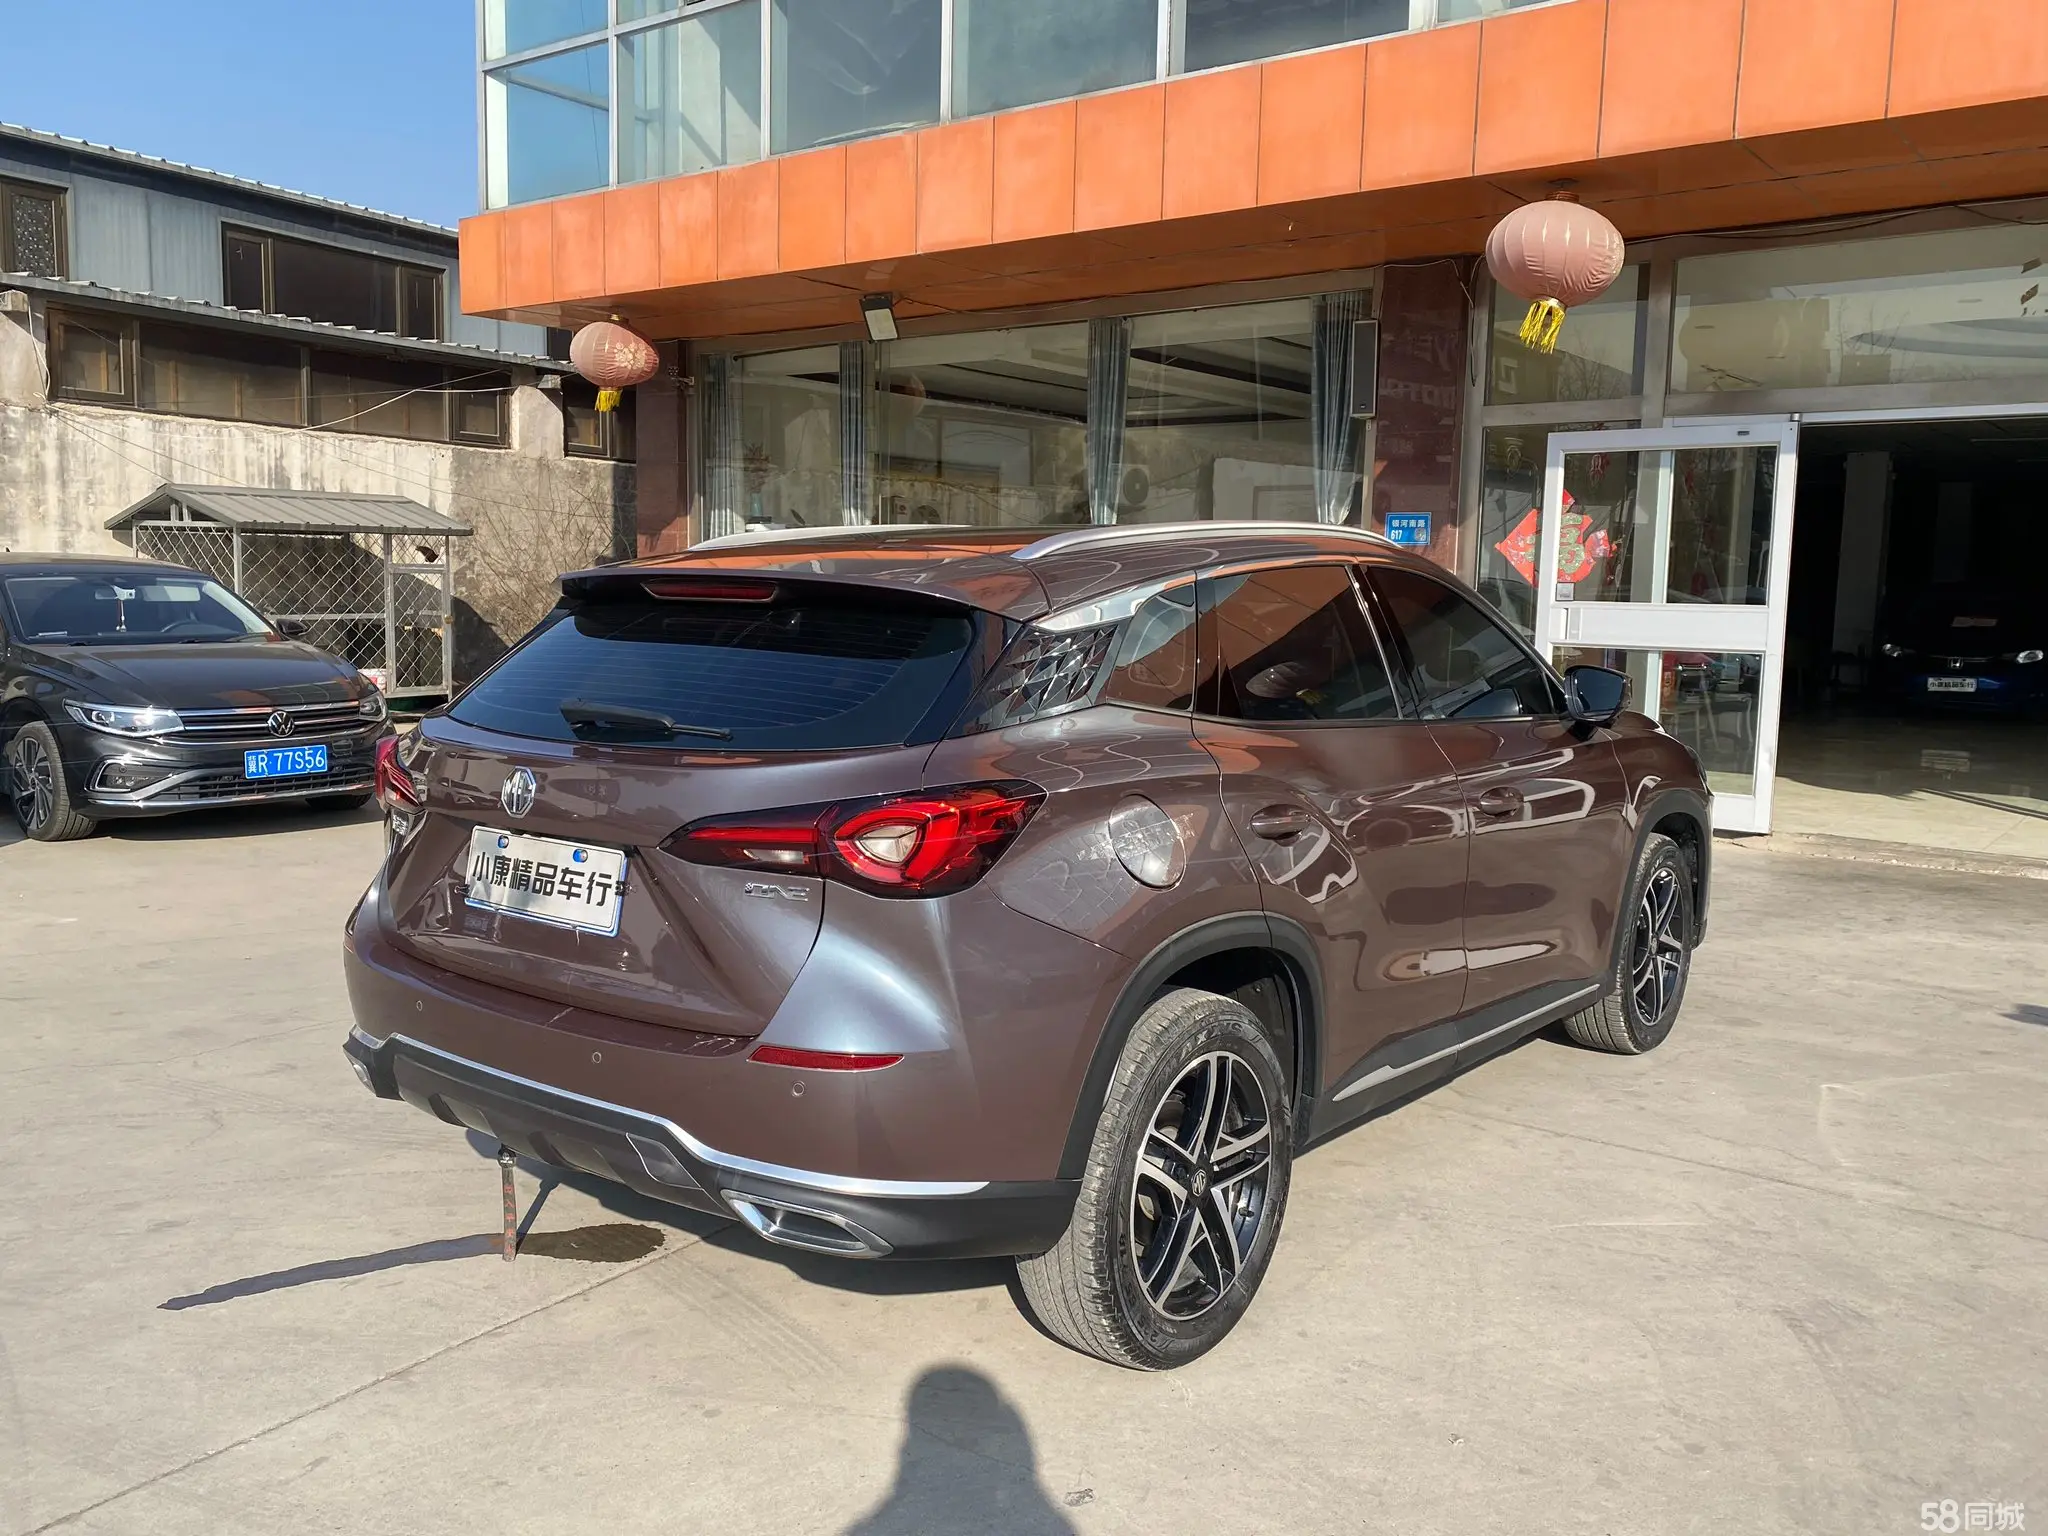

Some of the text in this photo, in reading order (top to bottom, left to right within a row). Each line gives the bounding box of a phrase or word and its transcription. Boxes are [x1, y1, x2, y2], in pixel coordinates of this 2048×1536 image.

[1390, 529, 1403, 540] 617
[472, 851, 613, 907] 小康精品车行
